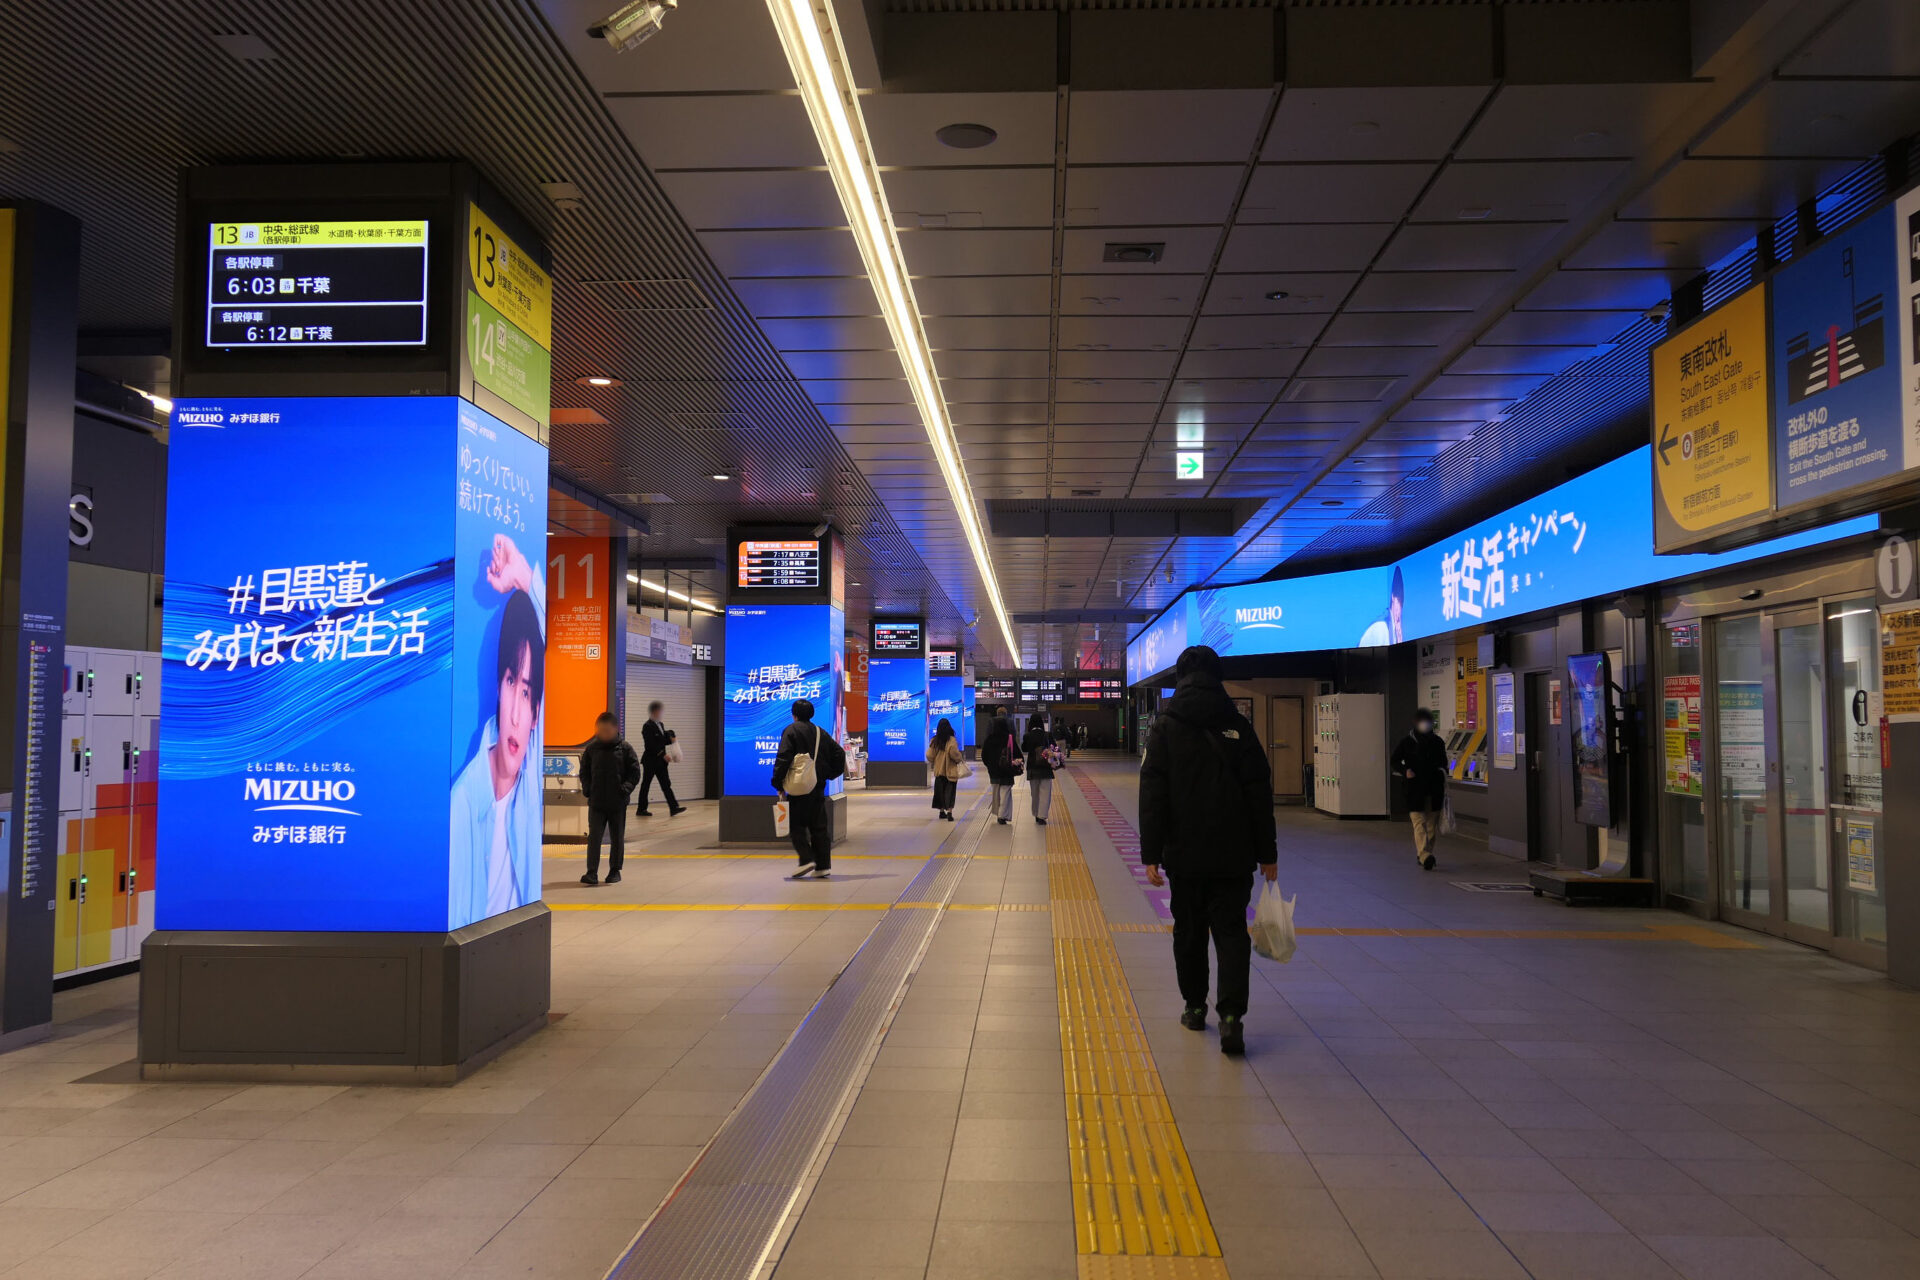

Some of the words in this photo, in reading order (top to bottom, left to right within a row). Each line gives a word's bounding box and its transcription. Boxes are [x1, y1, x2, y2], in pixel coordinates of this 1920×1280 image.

[217, 226, 238, 244] 13
[263, 224, 320, 236] 中央・総武線
[328, 229, 422, 238] 水道橋・秋葉原・千葉方面
[225, 256, 274, 269] 各駅停車
[474, 226, 496, 288] 13
[228, 277, 275, 294] 6:03
[297, 277, 330, 294] 千葉
[222, 311, 263, 323] 各駅停車
[247, 326, 287, 341] 6:12
[305, 326, 333, 340] 千葉
[472, 312, 495, 376] 14
[1680, 328, 1732, 381] 東南改札
[1681, 380, 1702, 403] South
[1704, 370, 1721, 391] East
[1723, 360, 1742, 380] Gate
[178, 413, 224, 423] MIZUHO
[229, 413, 280, 424] みずほ銀行
[1788, 407, 1828, 437] 改札外の
[1789, 417, 1860, 460] 横断歩道を渡る
[1790, 462, 1802, 474] Exit
[1803, 458, 1813, 470] the
[1814, 450, 1834, 465] South
[1835, 445, 1852, 458] Gate
[1853, 437, 1867, 452] and
[1790, 474, 1807, 487] cross
[1808, 470, 1818, 481] the
[1819, 459, 1854, 480] pedestrian
[1855, 448, 1888, 466] crossing.
[460, 443, 534, 503] ゆっくりでいい。
[460, 479, 525, 531] 続けてみよう。
[227, 560, 386, 615] #目黒蓮と
[550, 553, 594, 600] 11
[1441, 530, 1505, 621] 新生活
[1235, 606, 1282, 624] MIZUHO
[185, 606, 430, 672] みずほで新生活
[747, 664, 806, 684] #目黒蓮と
[733, 680, 822, 704] みずほで新生活
[246, 762, 355, 772] ともに挑む。ともに実る。
[244, 778, 355, 801] MIZUHO
[252, 825, 346, 844] みずほ銀行
